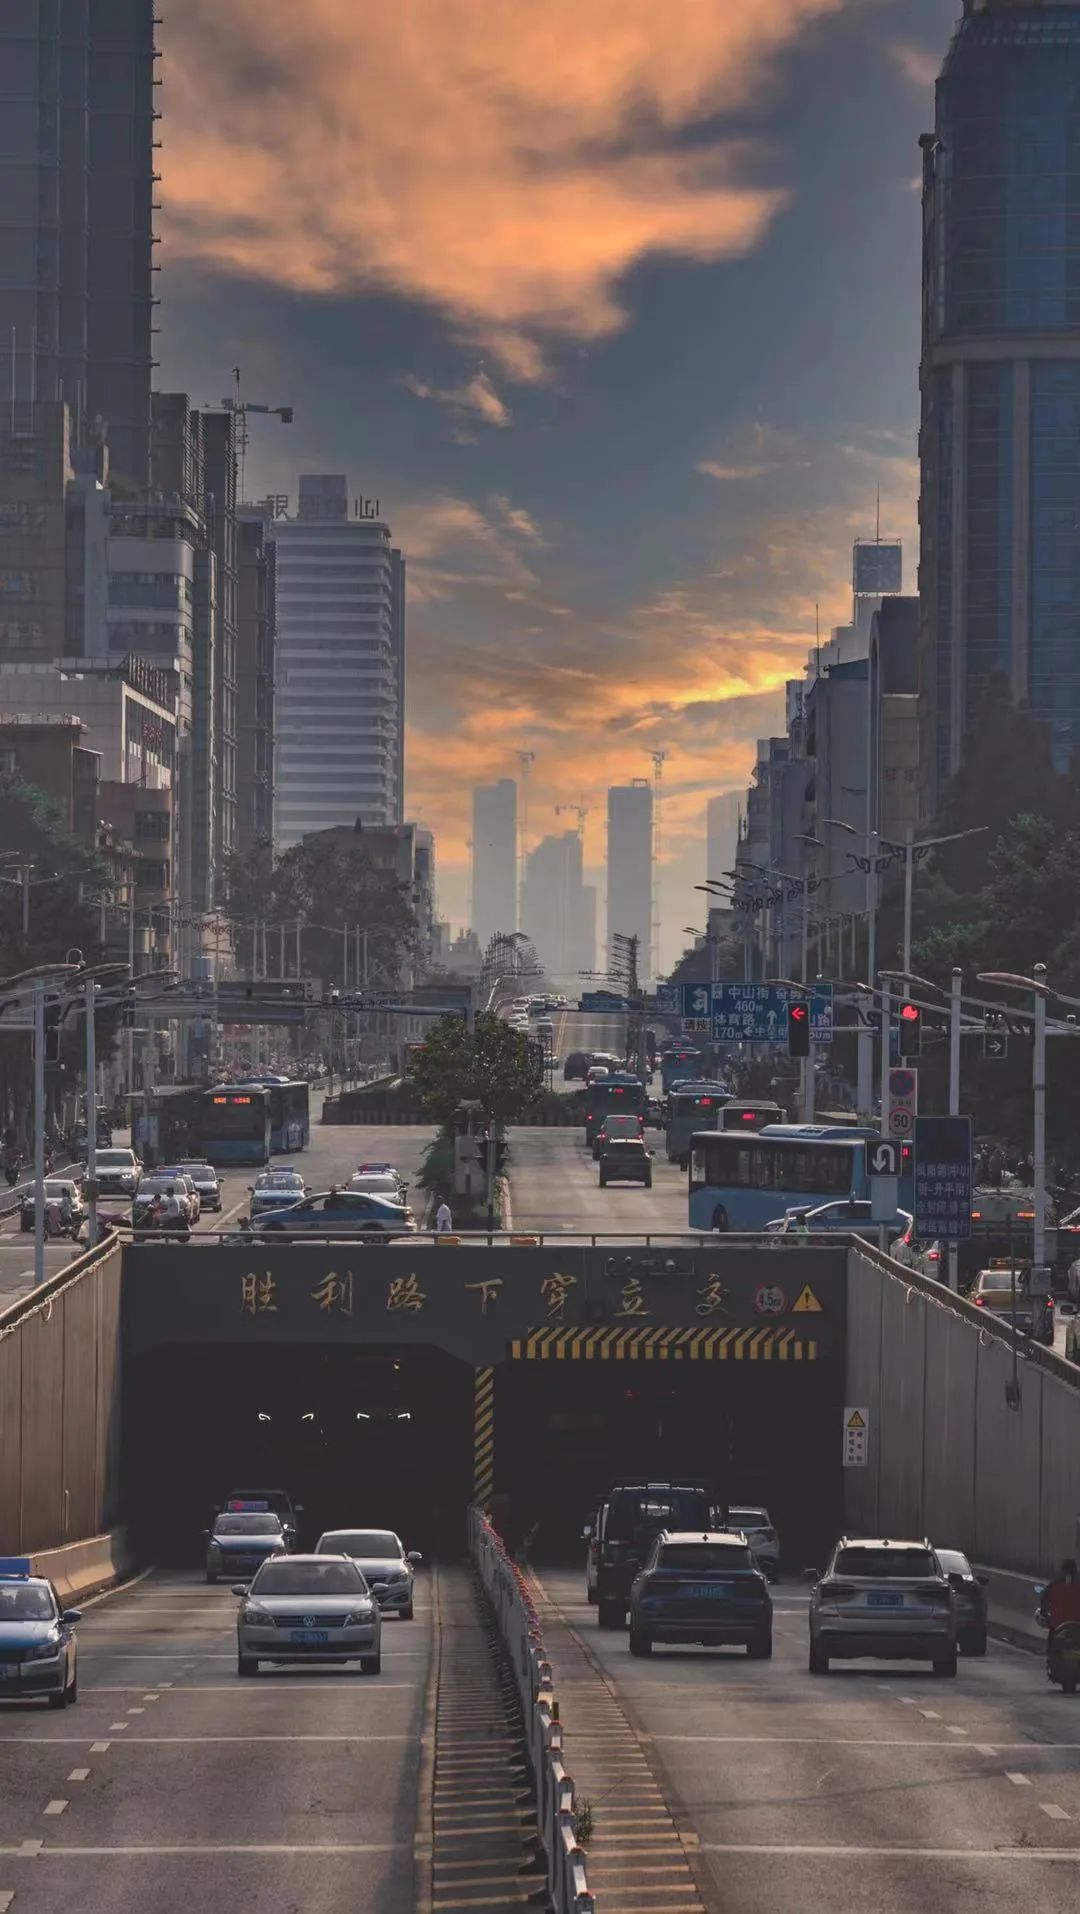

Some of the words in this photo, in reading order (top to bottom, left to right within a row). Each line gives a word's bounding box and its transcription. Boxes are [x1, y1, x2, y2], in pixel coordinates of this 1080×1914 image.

[728, 985, 769, 1000] 中山街
[714, 1027, 743, 1039] 170m
[894, 1114, 908, 1128] 50
[241, 1271, 729, 1320] 胜利路下穿立交
